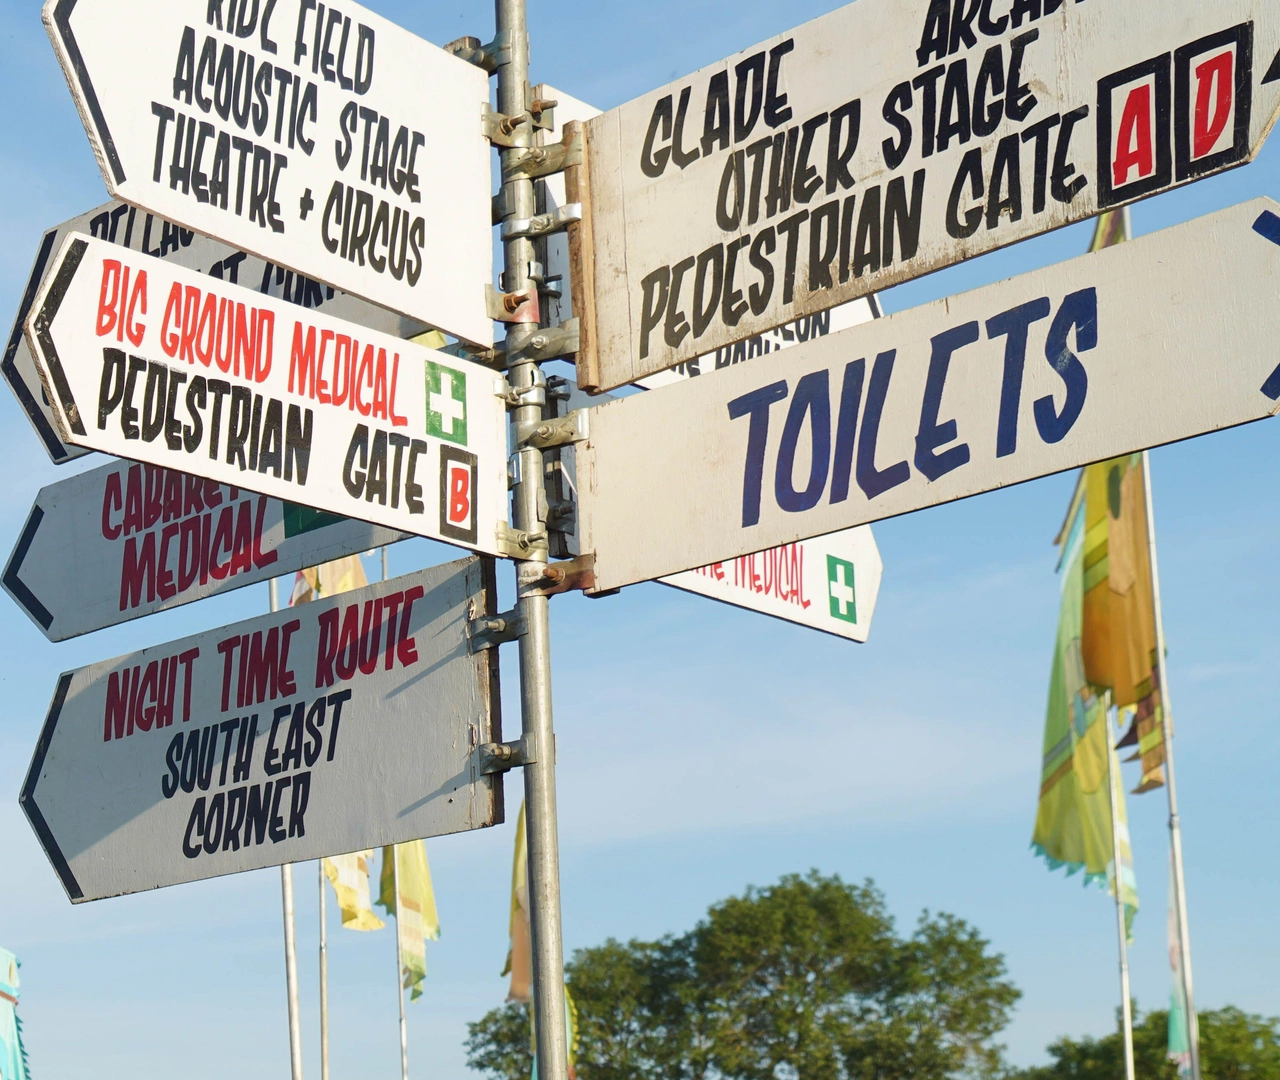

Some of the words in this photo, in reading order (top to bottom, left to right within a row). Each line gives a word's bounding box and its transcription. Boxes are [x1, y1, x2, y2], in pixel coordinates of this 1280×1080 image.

[173, 25, 318, 157] ACOUSTIC
[335, 101, 426, 204] STAGE
[293, 0, 375, 96] FIELD
[640, 38, 795, 179] GLADE
[151, 101, 288, 234] THEATRE
[321, 180, 426, 288] CIRCUS
[640, 168, 926, 361] PEDESTRIAN
[945, 104, 1089, 239] GATE
[1112, 83, 1153, 187] A
[1193, 50, 1233, 159] D
[716, 98, 861, 233] OTHER
[881, 28, 1040, 171] STAGE
[95, 258, 148, 349] BIG
[160, 280, 276, 385] GROUND
[287, 320, 408, 428] MEDICAL
[727, 286, 1098, 528] TOILETS
[96, 346, 314, 487] PEDESTRIAN
[342, 424, 428, 515] GATE
[449, 467, 471, 523] B
[101, 463, 240, 541] CABARE
[119, 495, 279, 612] MEDICAL
[734, 543, 812, 610] MEDICAL
[103, 646, 200, 743] NIGHT
[216, 618, 301, 712] TIME
[315, 585, 424, 689] ROUTE
[162, 715, 260, 799] SOUTH
[264, 689, 352, 778] EAST
[182, 771, 312, 859] CORNER
